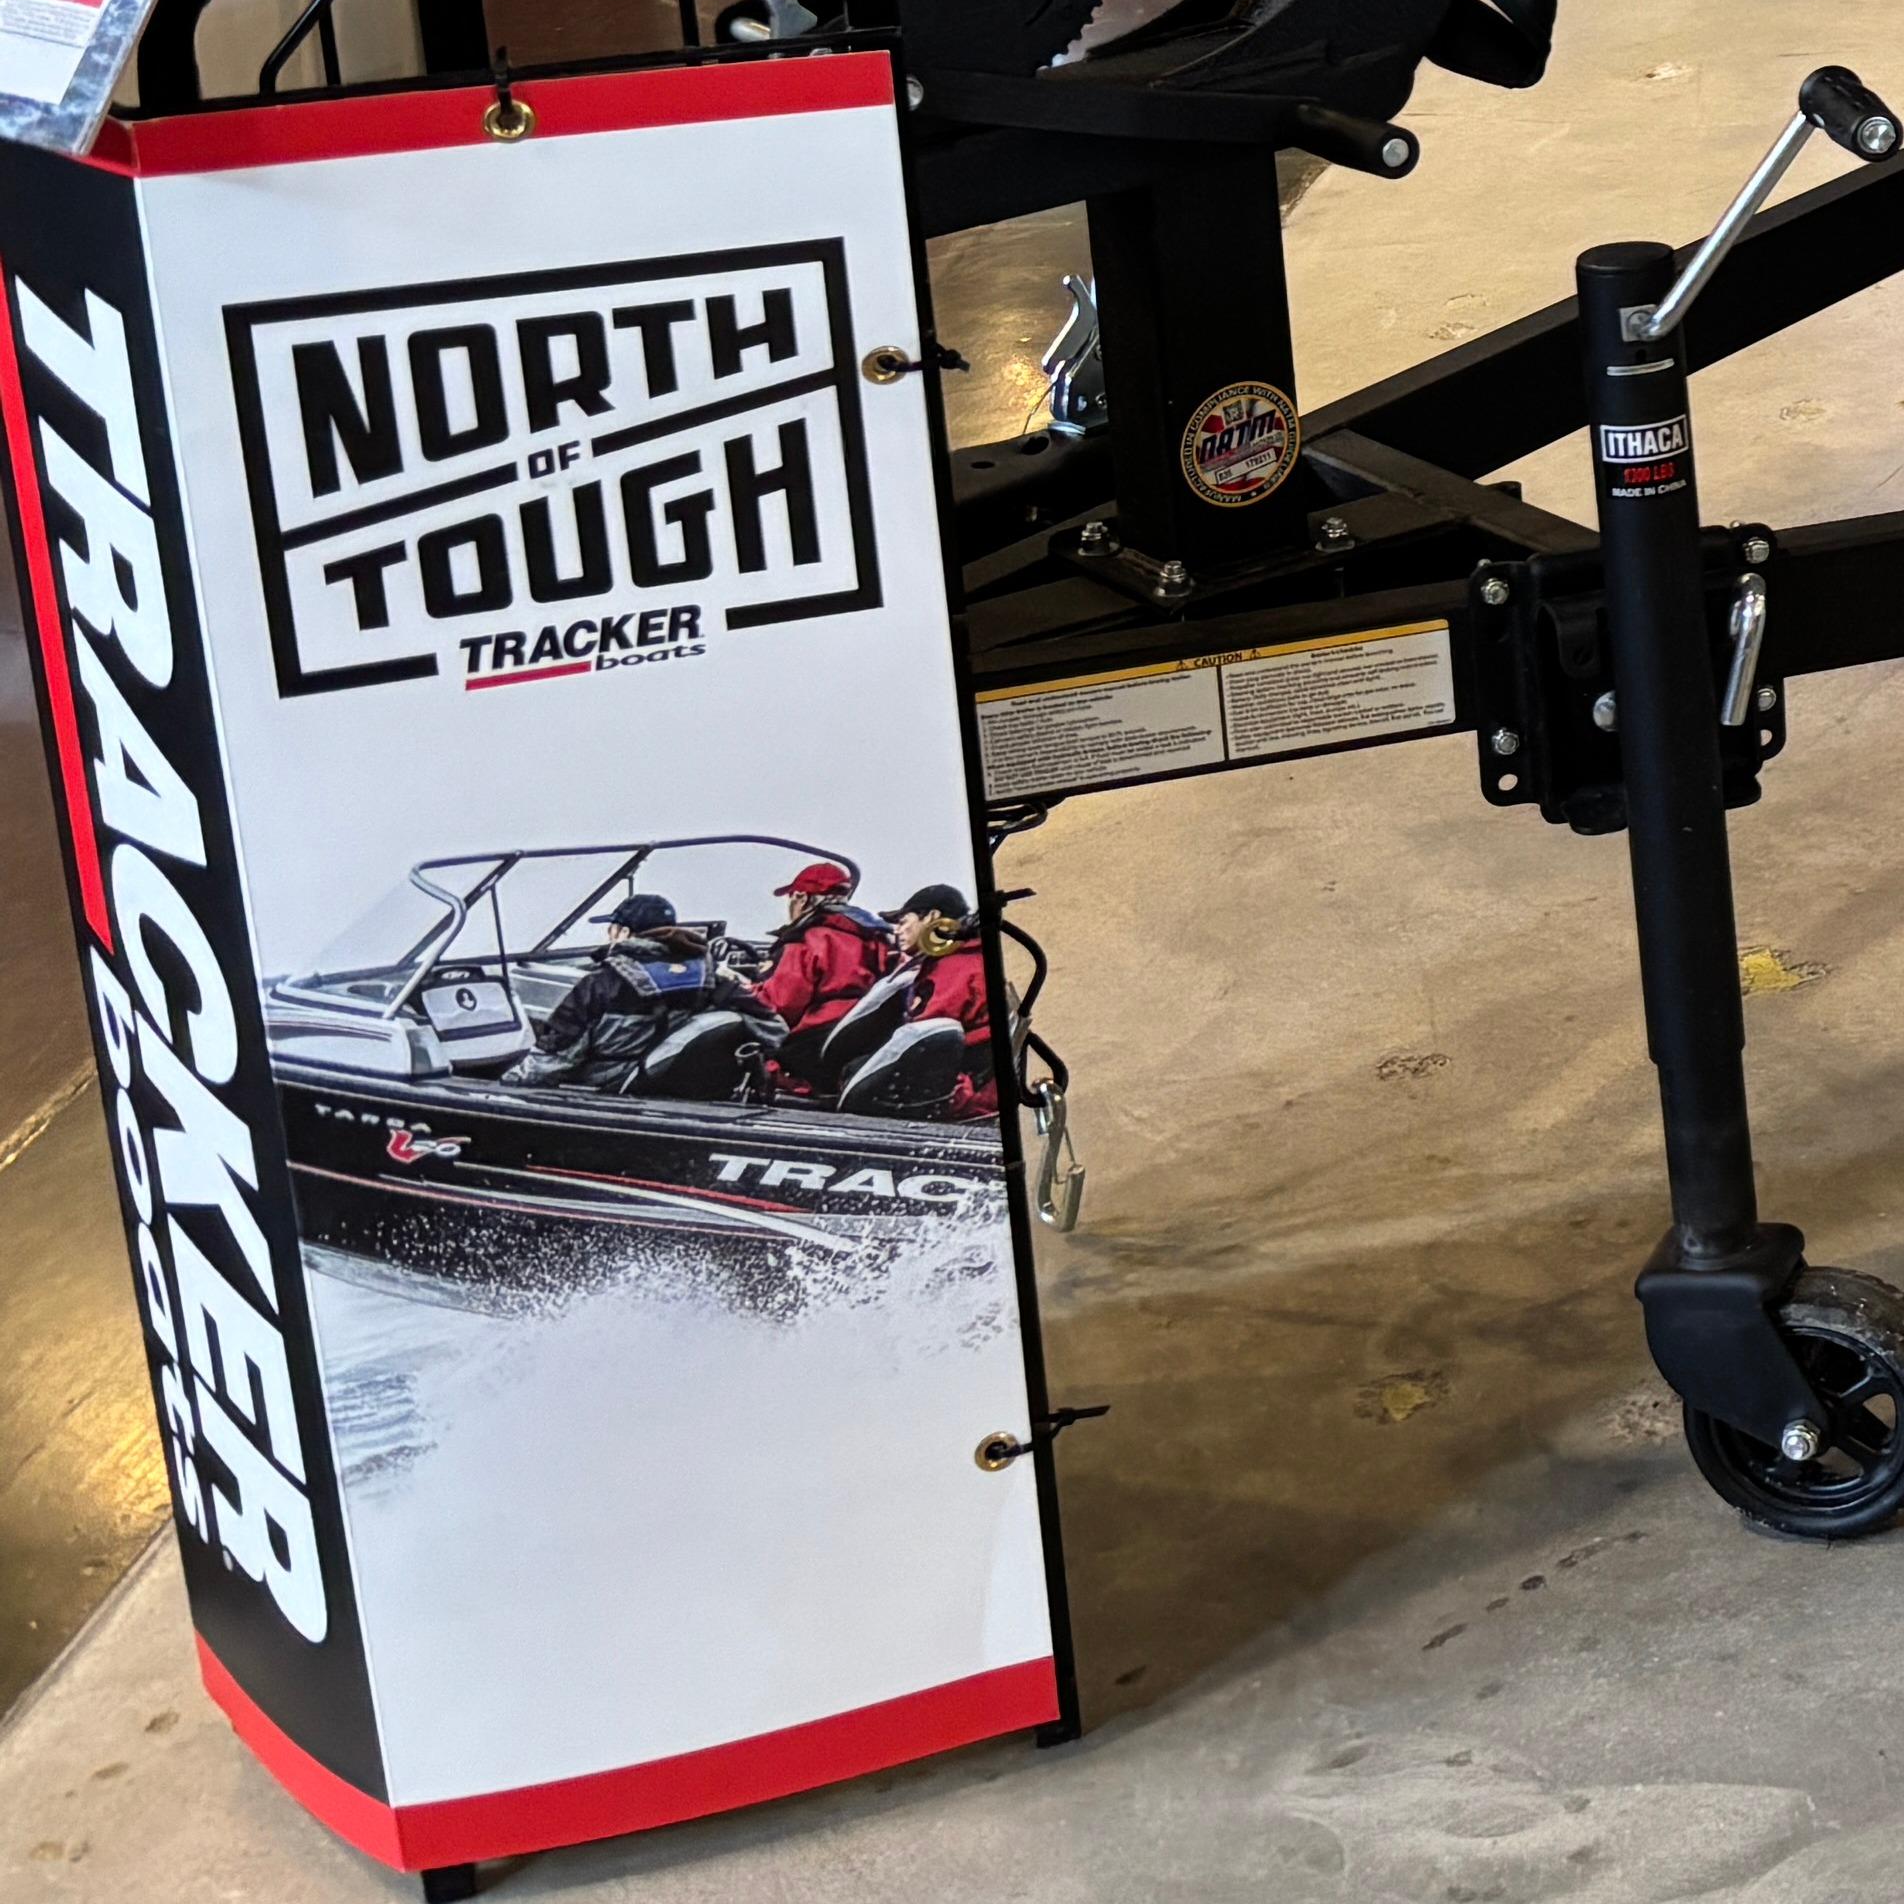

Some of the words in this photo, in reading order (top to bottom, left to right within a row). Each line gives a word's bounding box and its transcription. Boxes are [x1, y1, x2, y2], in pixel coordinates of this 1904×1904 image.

[291, 287, 800, 499] NORTH
[526, 438, 583, 479] OF
[1607, 423, 1684, 457] ITHACA
[323, 416, 823, 631] TOUGH
[459, 604, 704, 674] TRACKER
[596, 639, 707, 672] boats
[1193, 651, 1243, 668] CAUTION
[14, 270, 330, 1646] TRACKER
[708, 1152, 1006, 1203] TRAC
[88, 946, 209, 1546] boats
